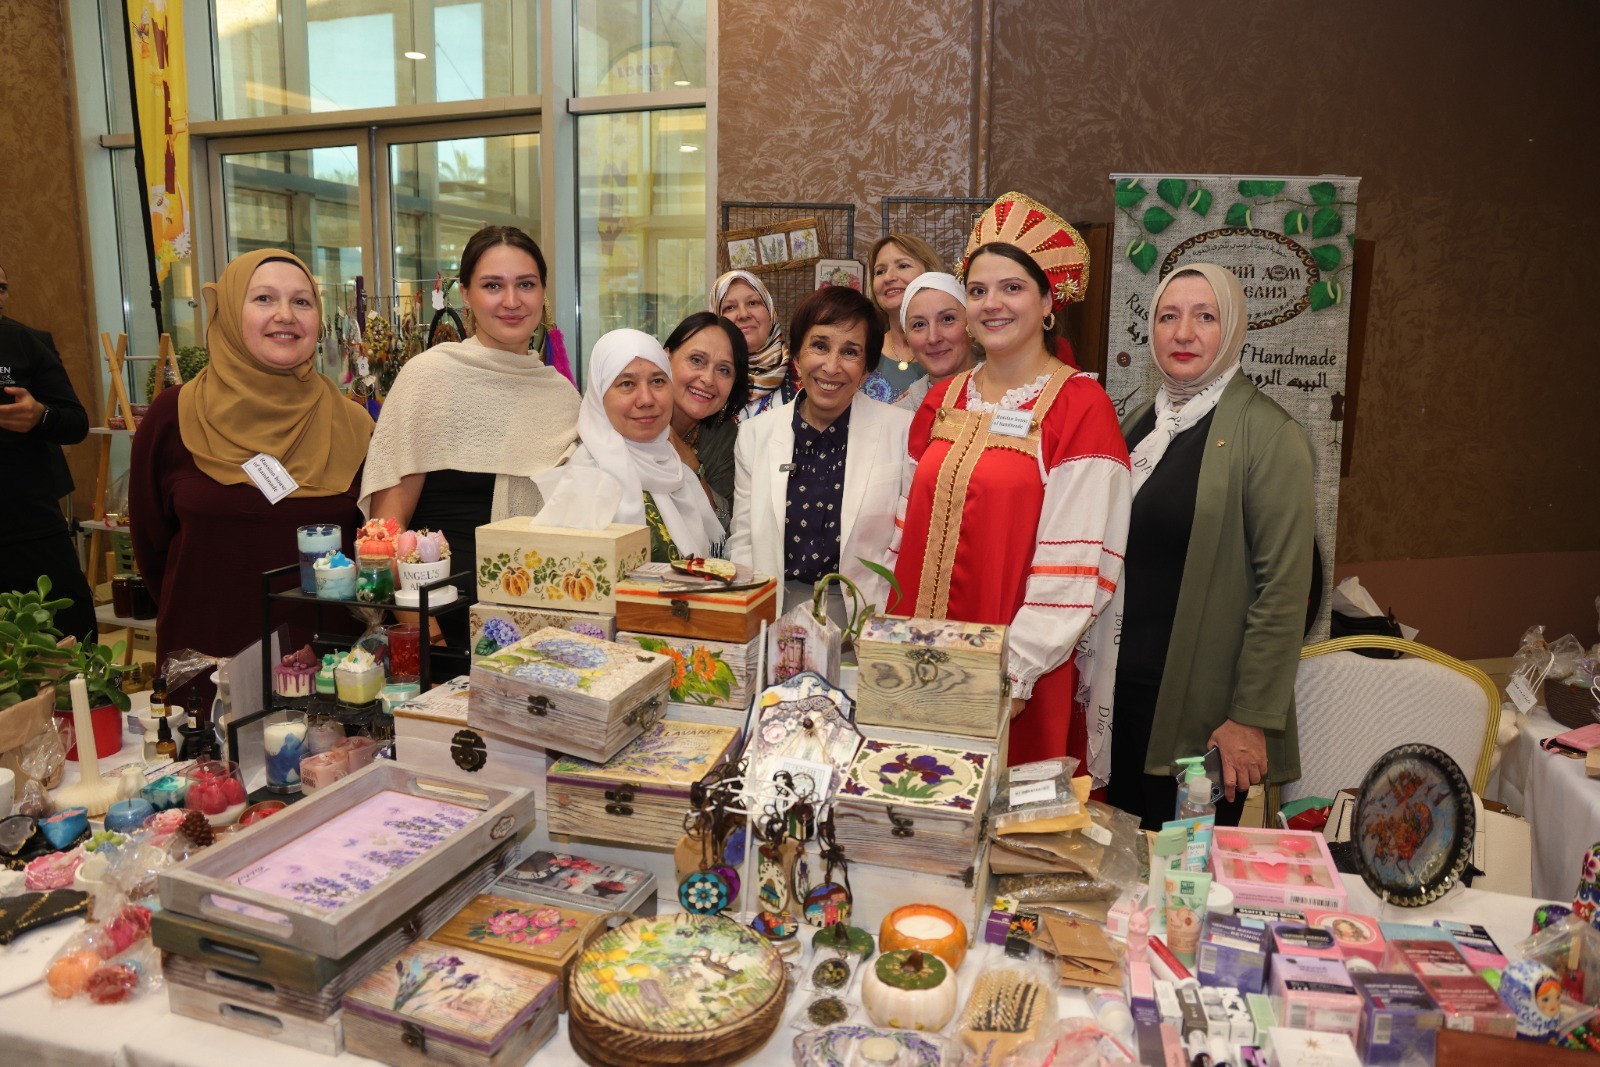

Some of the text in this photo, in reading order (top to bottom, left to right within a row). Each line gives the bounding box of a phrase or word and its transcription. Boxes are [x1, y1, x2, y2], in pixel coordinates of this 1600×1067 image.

[1251, 346, 1337, 366] Handmade
[1286, 371, 1329, 393] البيت
[259, 457, 276, 477] Russian
[257, 466, 278, 492] handmade
[402, 568, 441, 581] ANGEL'S
[1113, 611, 1123, 646] Dior
[1097, 705, 1111, 737] Dior
[663, 728, 725, 737] LAVANDE
